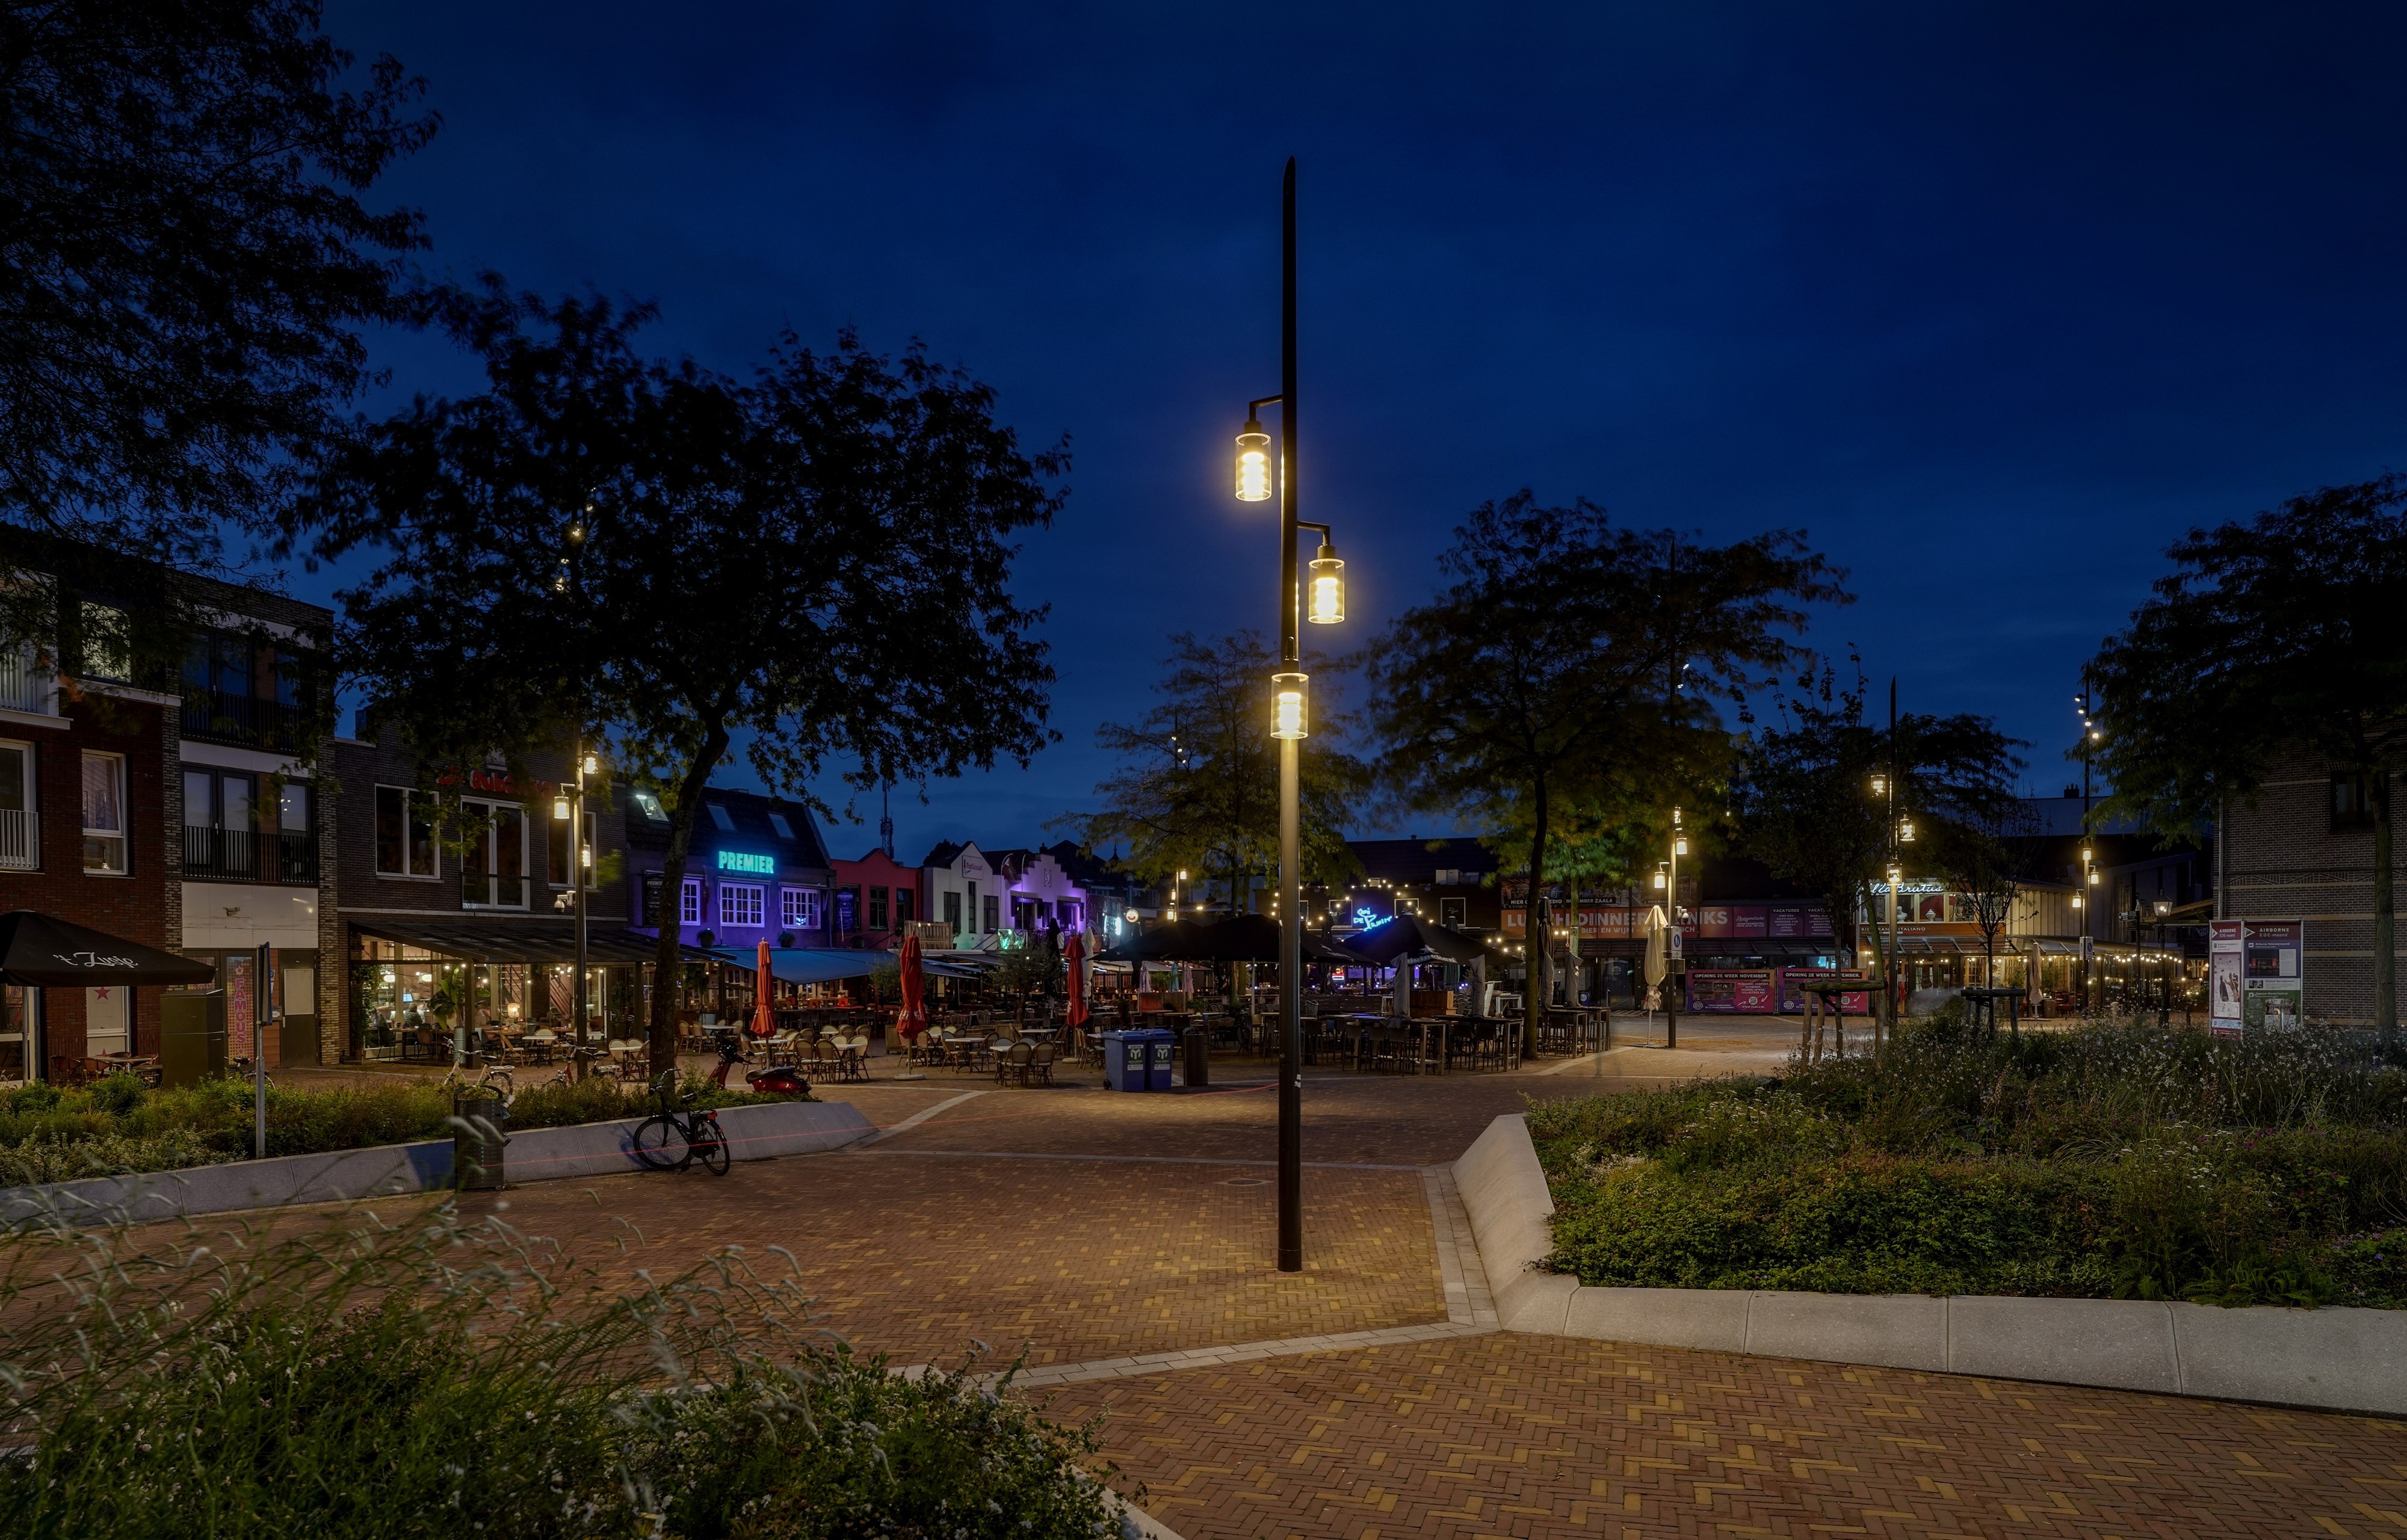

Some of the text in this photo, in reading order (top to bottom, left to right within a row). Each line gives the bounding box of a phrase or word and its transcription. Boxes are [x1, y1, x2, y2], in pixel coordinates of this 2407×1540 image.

[718, 851, 774, 873] PREMIER
[1897, 882, 1944, 893] Brutus
[73, 952, 138, 968] Zusje
[233, 978, 247, 1044] FAMOUS
